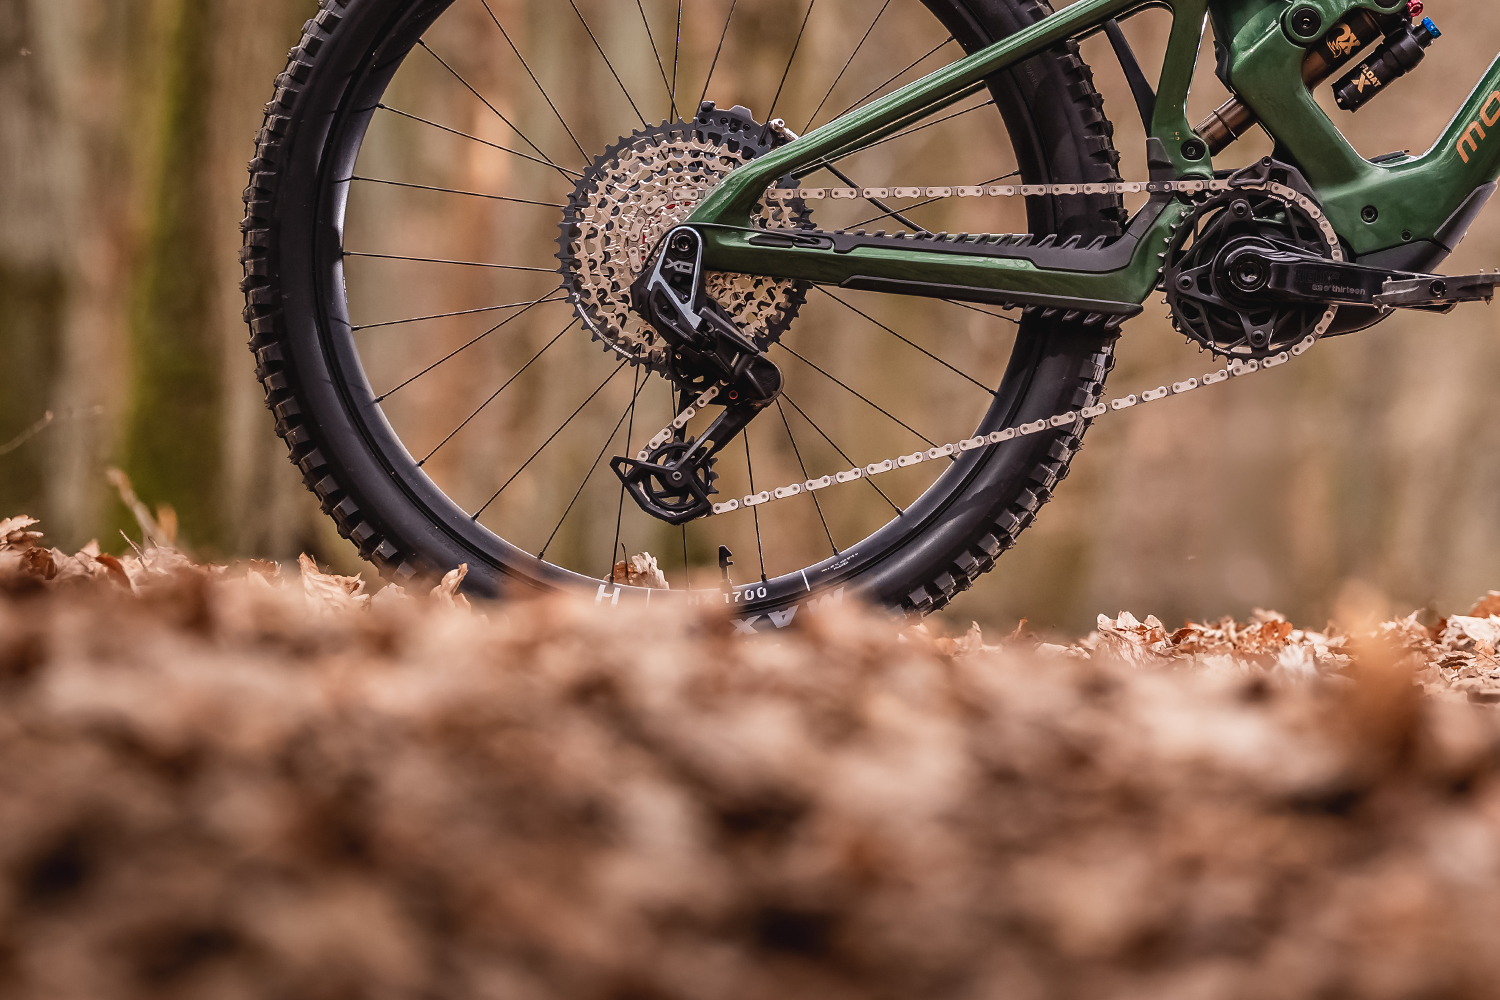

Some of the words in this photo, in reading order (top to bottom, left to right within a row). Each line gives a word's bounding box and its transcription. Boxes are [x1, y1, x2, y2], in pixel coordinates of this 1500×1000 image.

[1351, 72, 1372, 93] X
[1359, 63, 1382, 88] FLOAT
[594, 583, 621, 608] H
[723, 586, 767, 604] 1700
[729, 586, 845, 637] MAX
